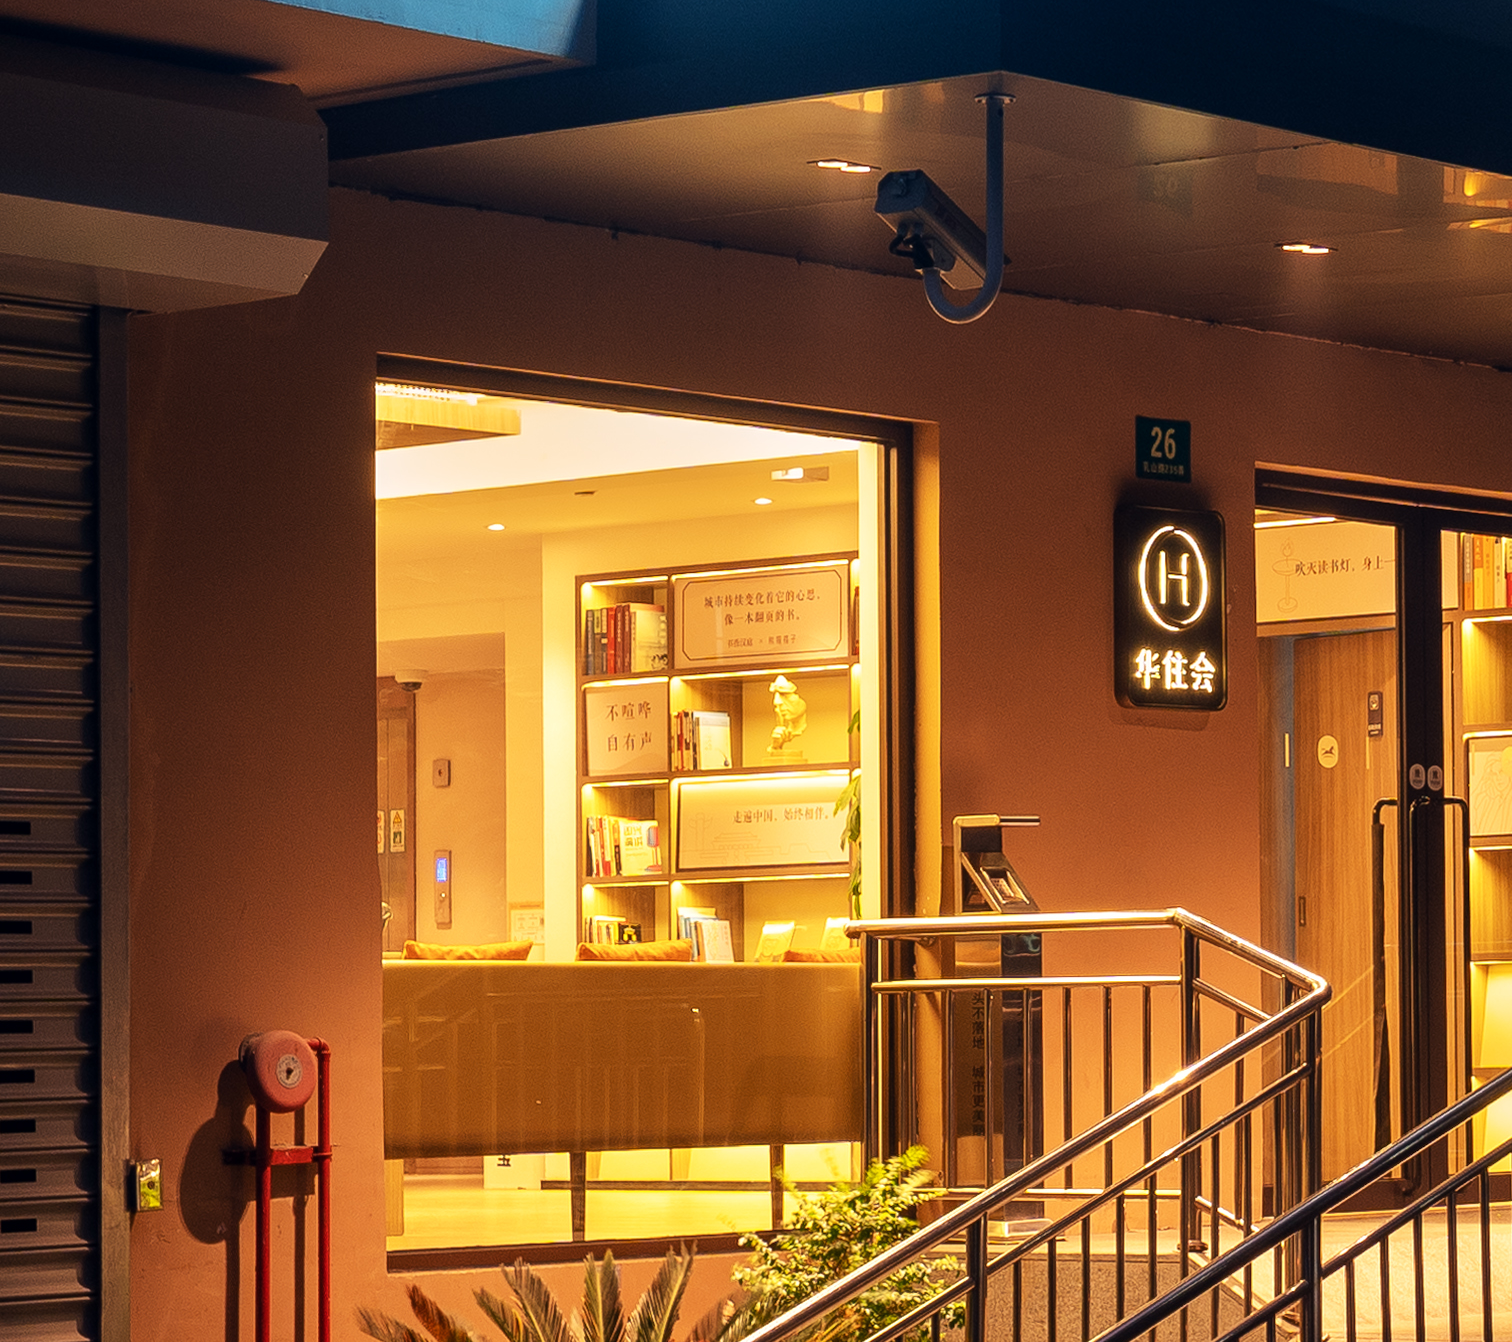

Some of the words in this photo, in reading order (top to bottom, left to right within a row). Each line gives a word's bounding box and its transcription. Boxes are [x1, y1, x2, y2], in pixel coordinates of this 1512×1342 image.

[1150, 425, 1177, 460] 26
[1135, 646, 1217, 694] 华住会
[605, 700, 652, 722] 不喧哗
[607, 731, 652, 752] 自有声
